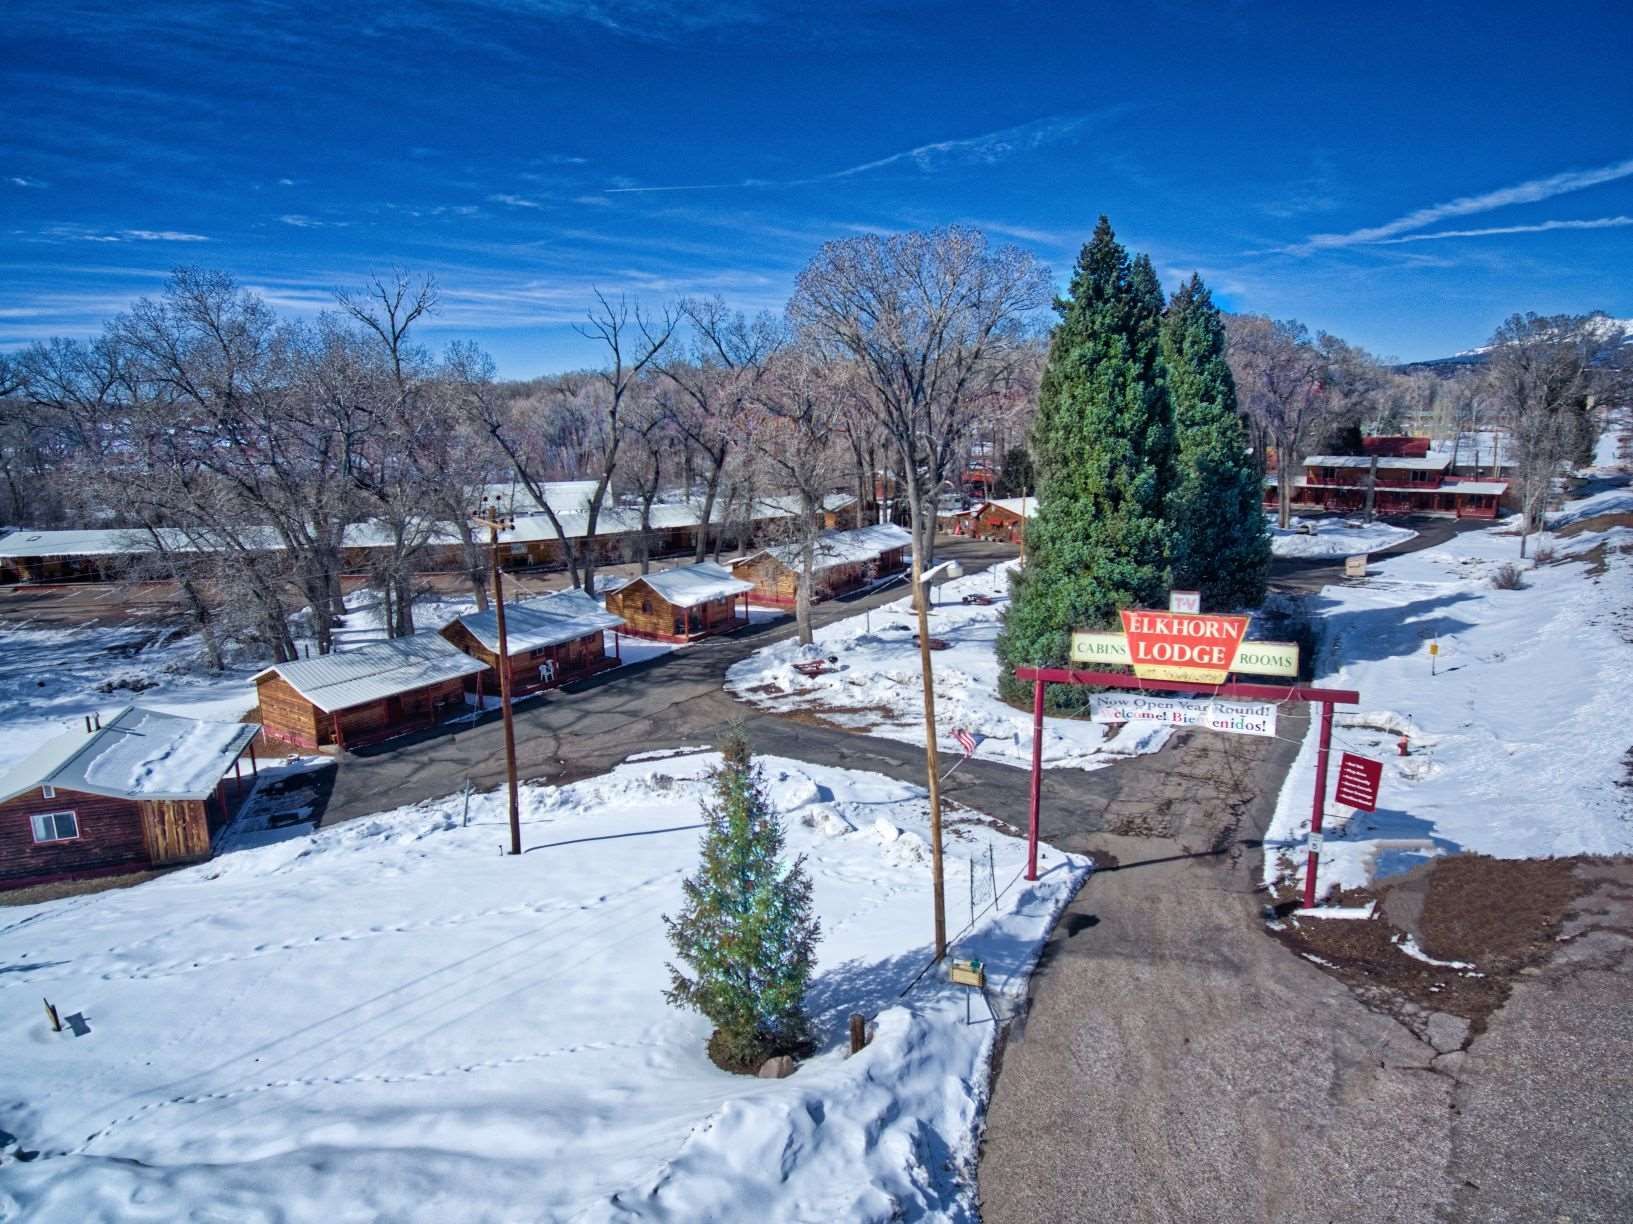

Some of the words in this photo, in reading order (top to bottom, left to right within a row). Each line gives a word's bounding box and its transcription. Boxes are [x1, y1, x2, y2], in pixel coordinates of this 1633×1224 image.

[1129, 615, 1239, 639] ELKHORN
[1077, 642, 1126, 656] CABINS
[1137, 641, 1226, 665] LODGE
[1239, 653, 1293, 668] ROOMS
[1097, 697, 1129, 708] Now
[1133, 698, 1174, 711] Open
[1178, 701, 1209, 712] Year
[1214, 703, 1270, 718] Round!
